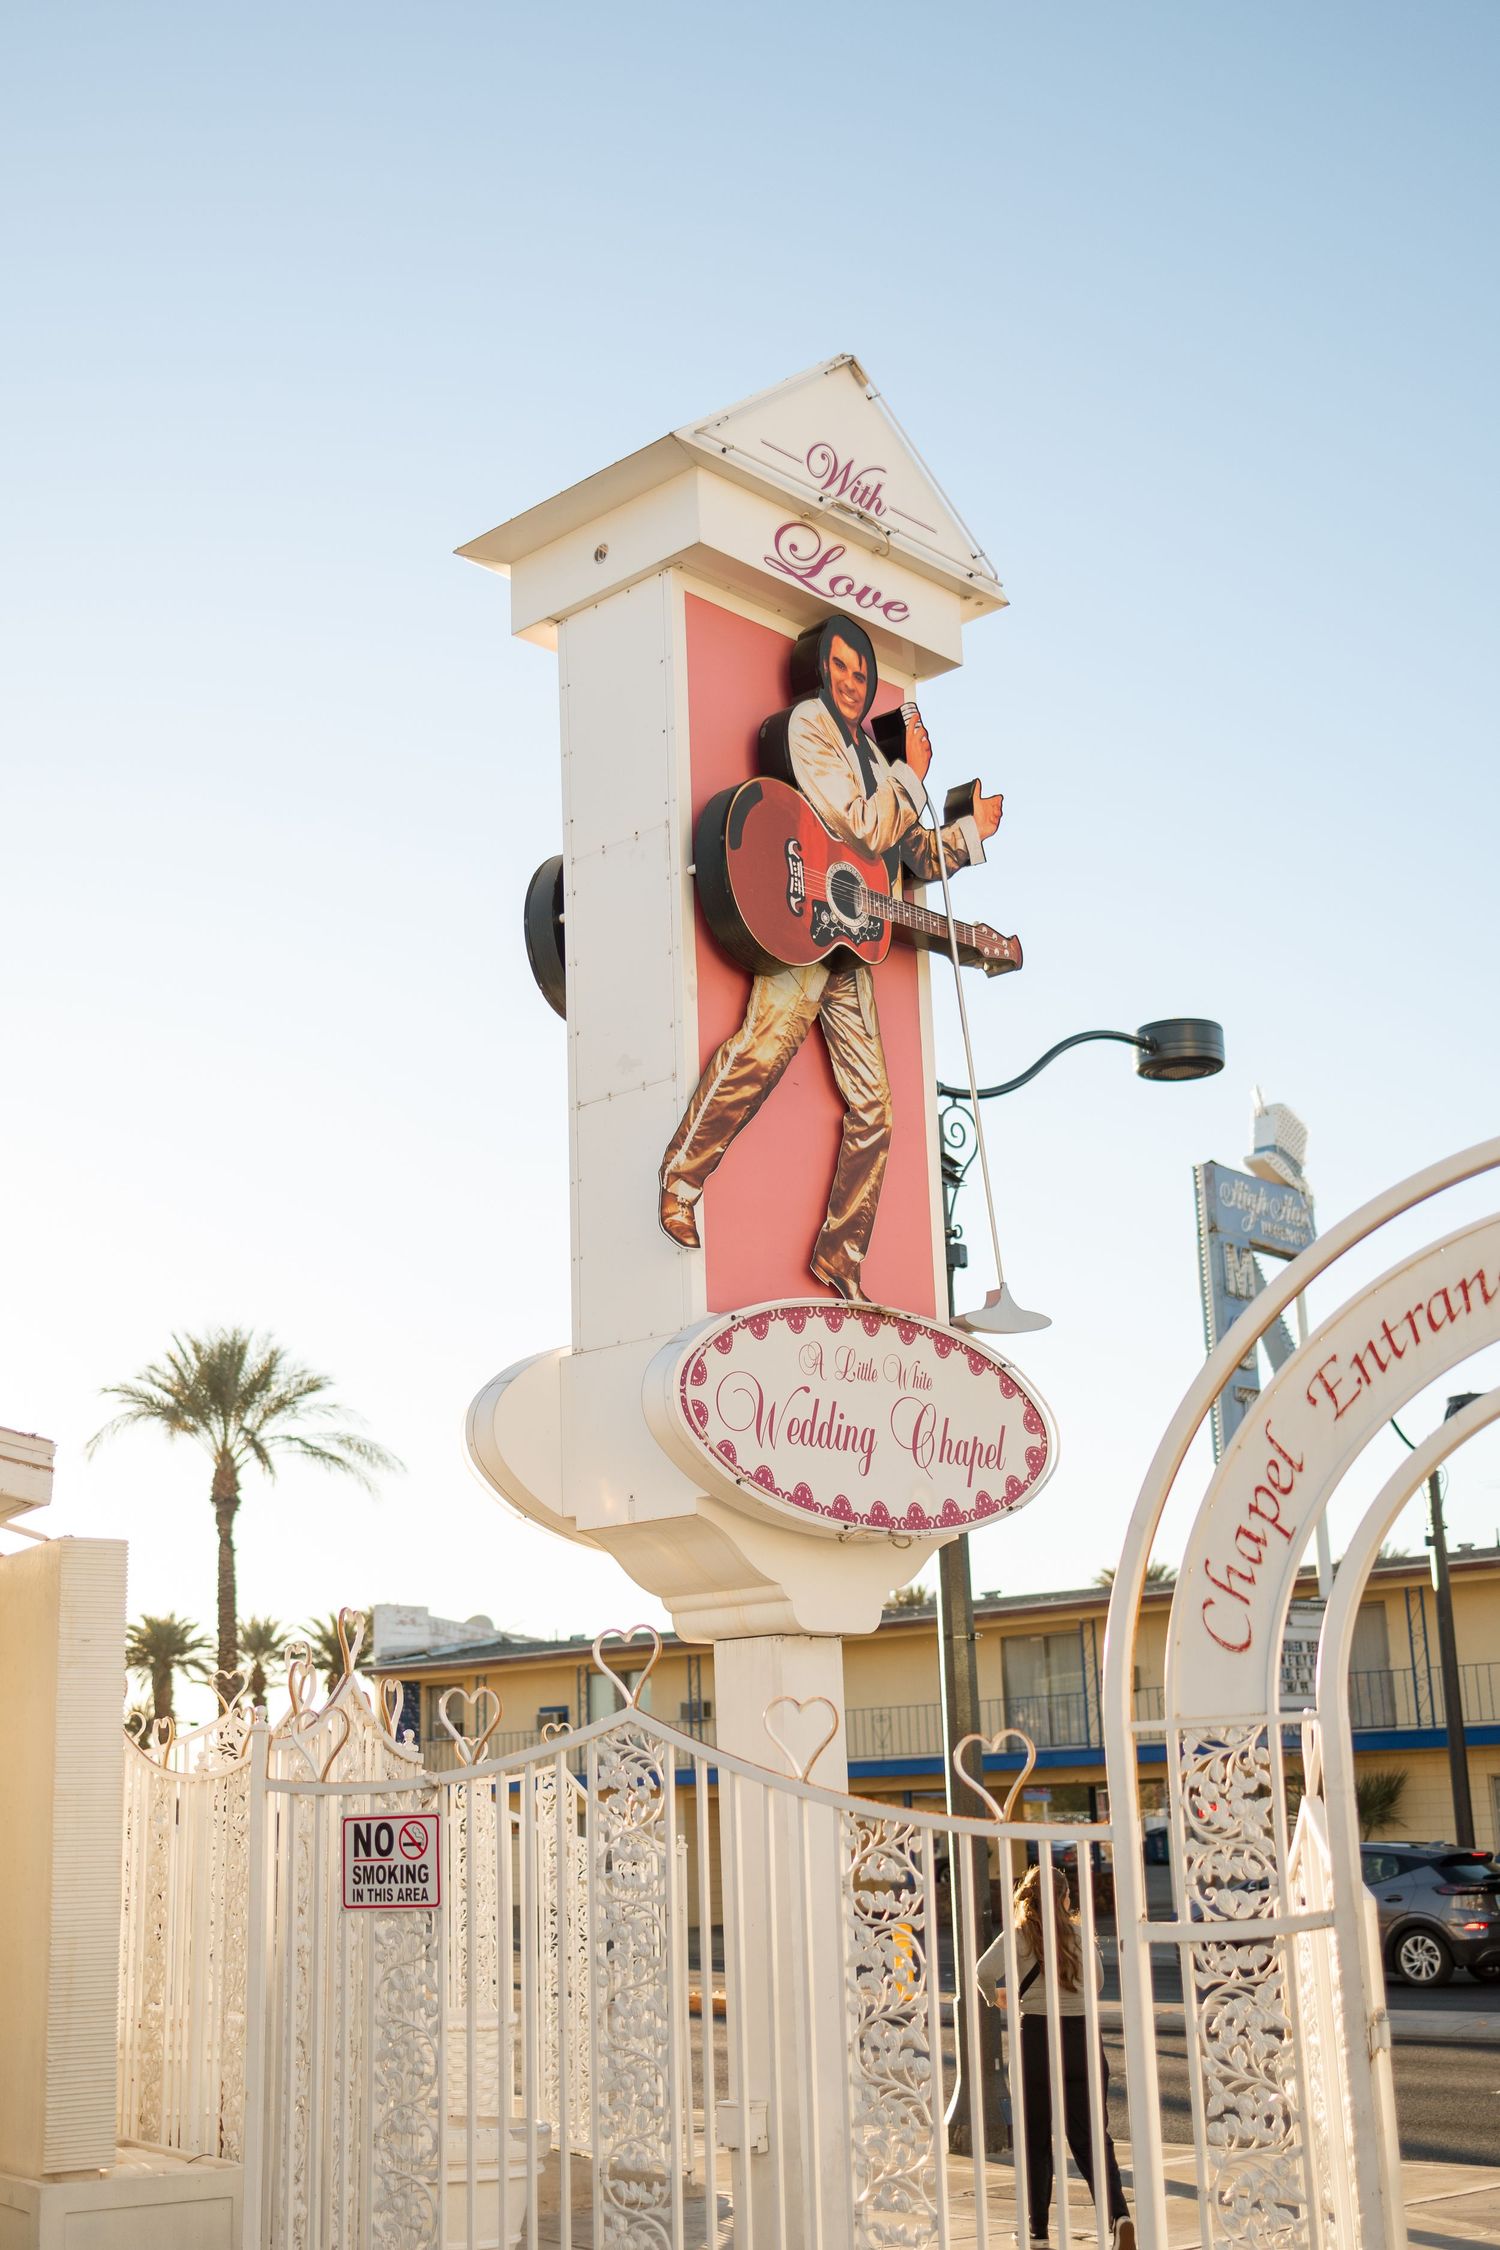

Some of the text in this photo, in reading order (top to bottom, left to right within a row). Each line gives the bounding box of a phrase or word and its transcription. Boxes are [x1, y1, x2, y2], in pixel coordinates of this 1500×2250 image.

[806, 443, 887, 517] With
[763, 521, 910, 622] Love
[1220, 1179, 1268, 1233] High
[799, 1341, 933, 1391] A Little White
[716, 1371, 1006, 1488] Wedding Chapel
[1202, 1269, 1500, 1653] Chapel Entran
[353, 1822, 394, 1858] NO
[352, 1864, 430, 1885] SMOKING
[352, 1887, 429, 1903] IN THIS AREA
